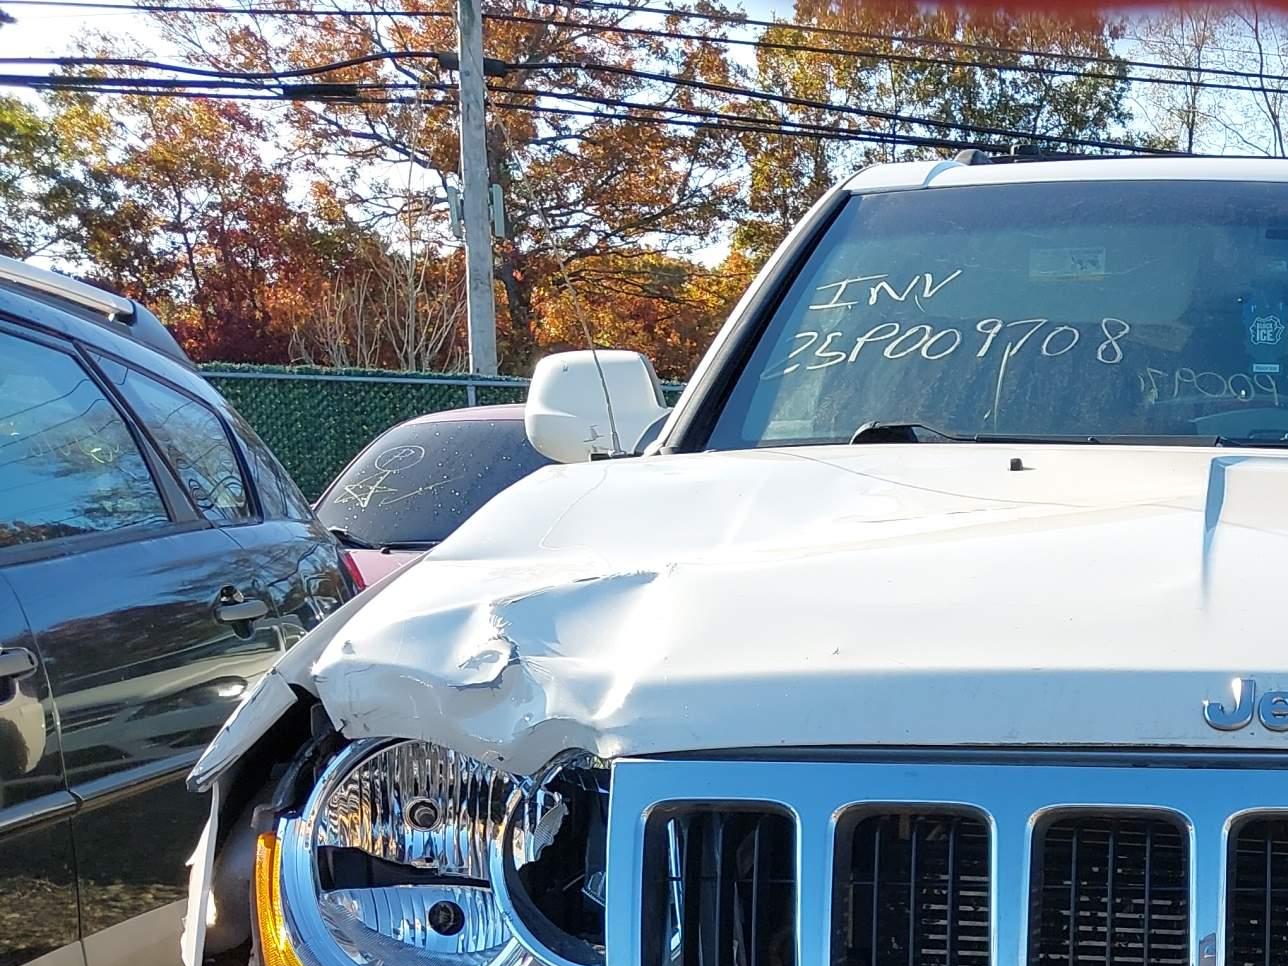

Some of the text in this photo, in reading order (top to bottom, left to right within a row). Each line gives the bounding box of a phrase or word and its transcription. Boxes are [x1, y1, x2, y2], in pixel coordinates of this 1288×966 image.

[809, 270, 962, 312] INV
[780, 318, 1131, 374] 25P009708
[1256, 329, 1274, 342] ICE
